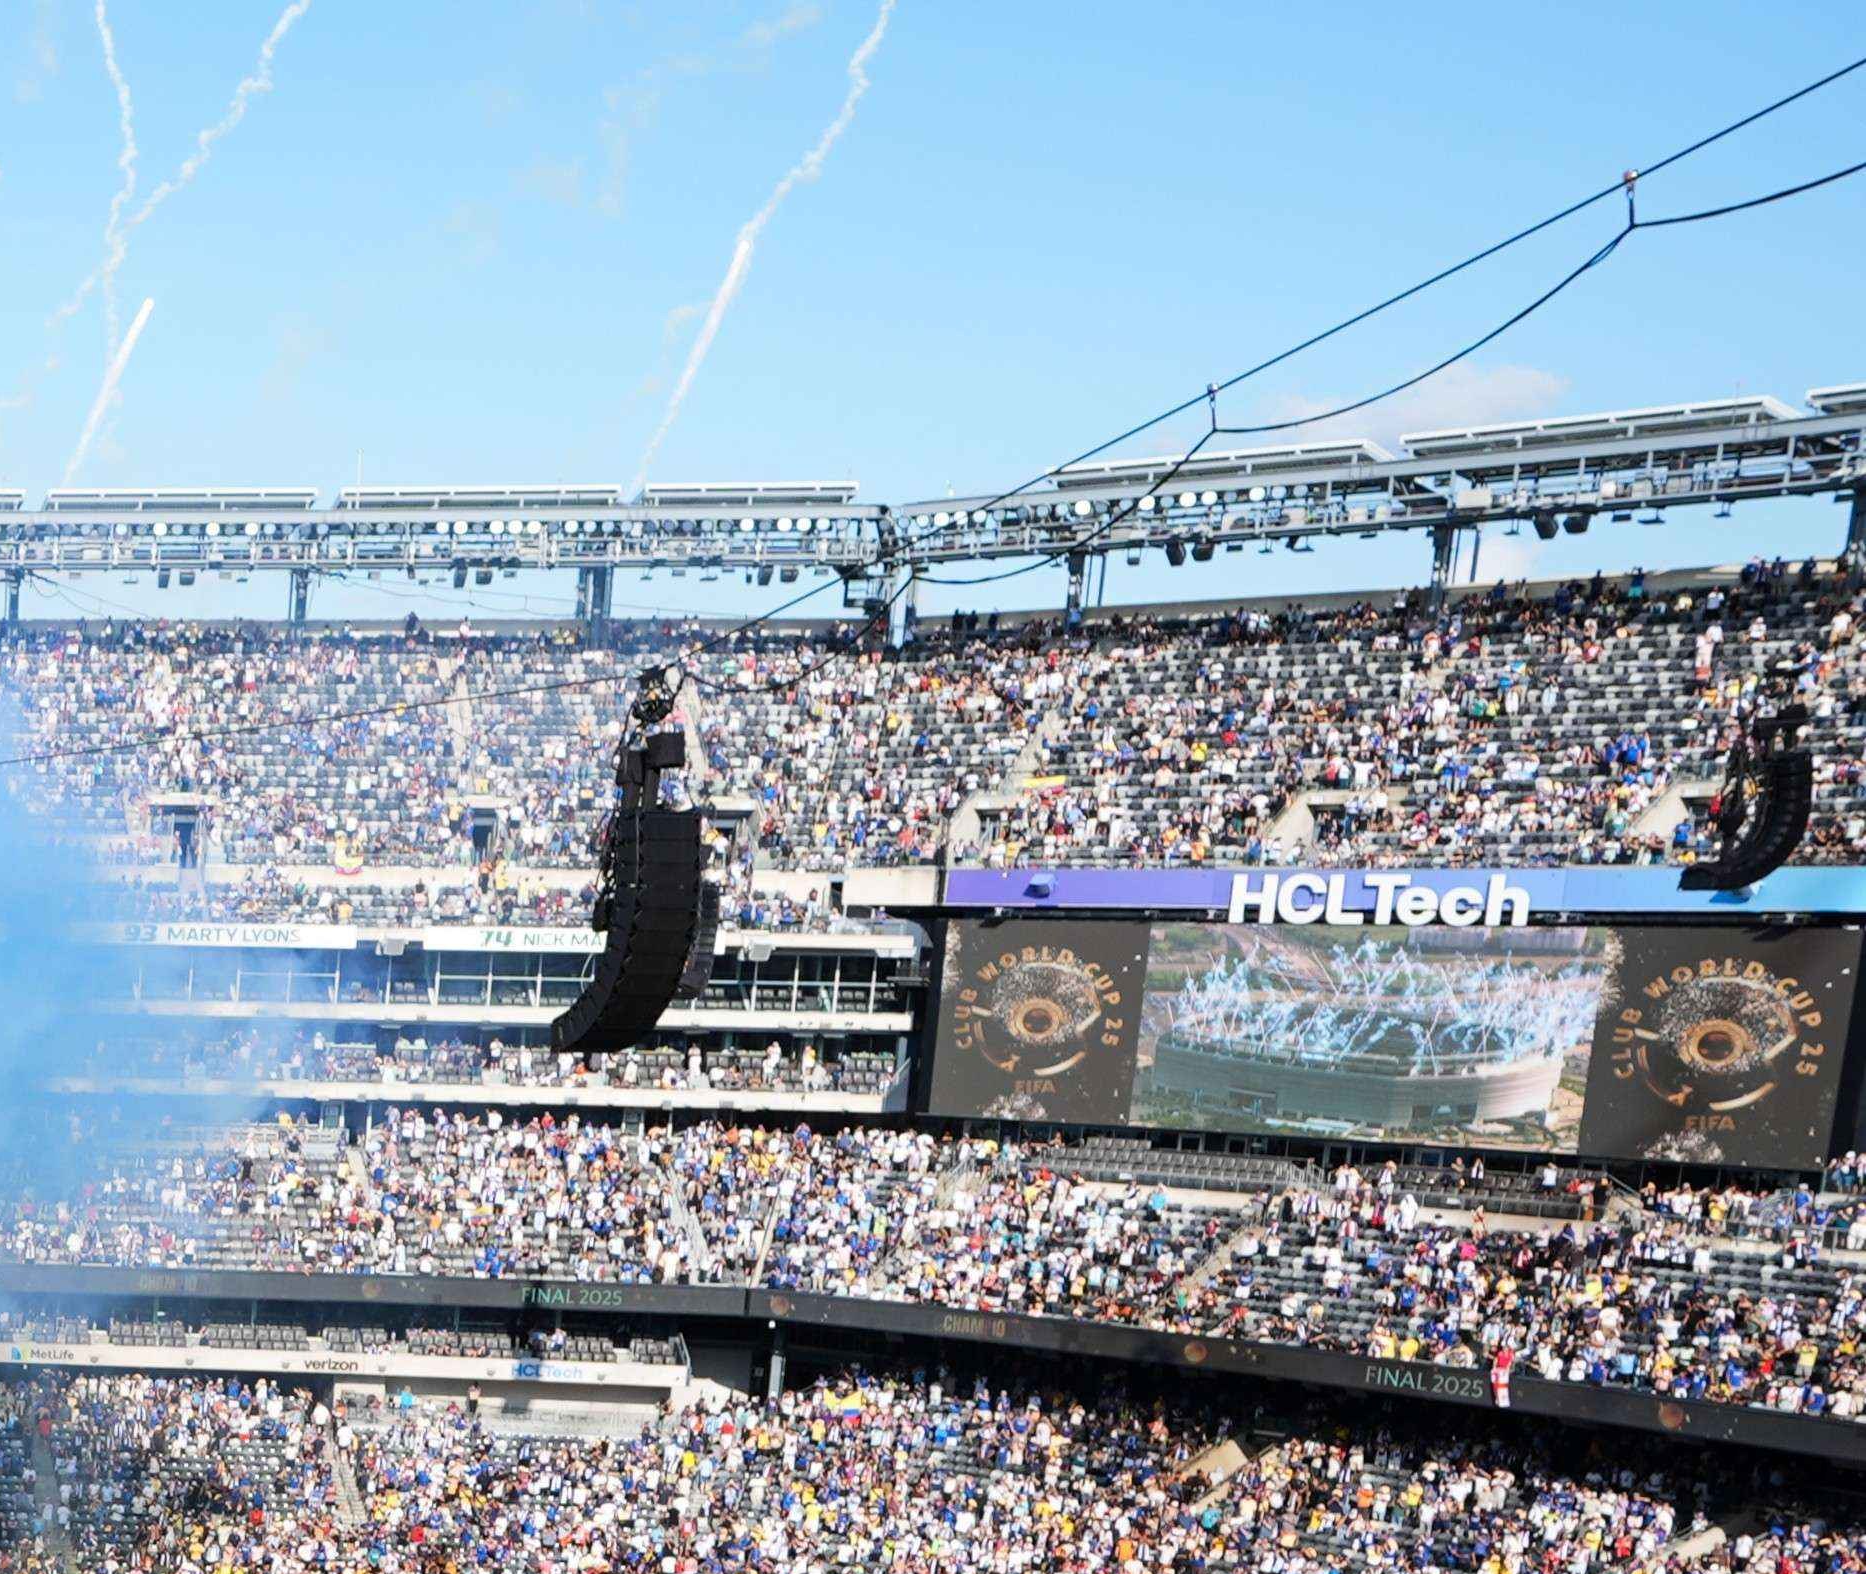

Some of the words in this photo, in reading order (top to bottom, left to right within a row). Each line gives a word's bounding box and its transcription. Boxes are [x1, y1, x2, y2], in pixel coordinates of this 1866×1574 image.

[1228, 872, 1531, 927] HCLTech
[167, 927, 238, 942] MARTY
[242, 927, 301, 943] LYONS
[479, 930, 513, 947] 74
[523, 932, 565, 946] NICK
[1013, 1079, 1056, 1094] FIFA
[1685, 1115, 1735, 1131] FIFA
[521, 1287, 574, 1304] FINAL
[579, 1289, 623, 1306] 2025
[30, 1349, 74, 1360] MetLife
[304, 1359, 358, 1371] verizon
[512, 1363, 583, 1379] HCLTech
[1364, 1366, 1428, 1391] FINAL
[1431, 1374, 1484, 1399] 2025
